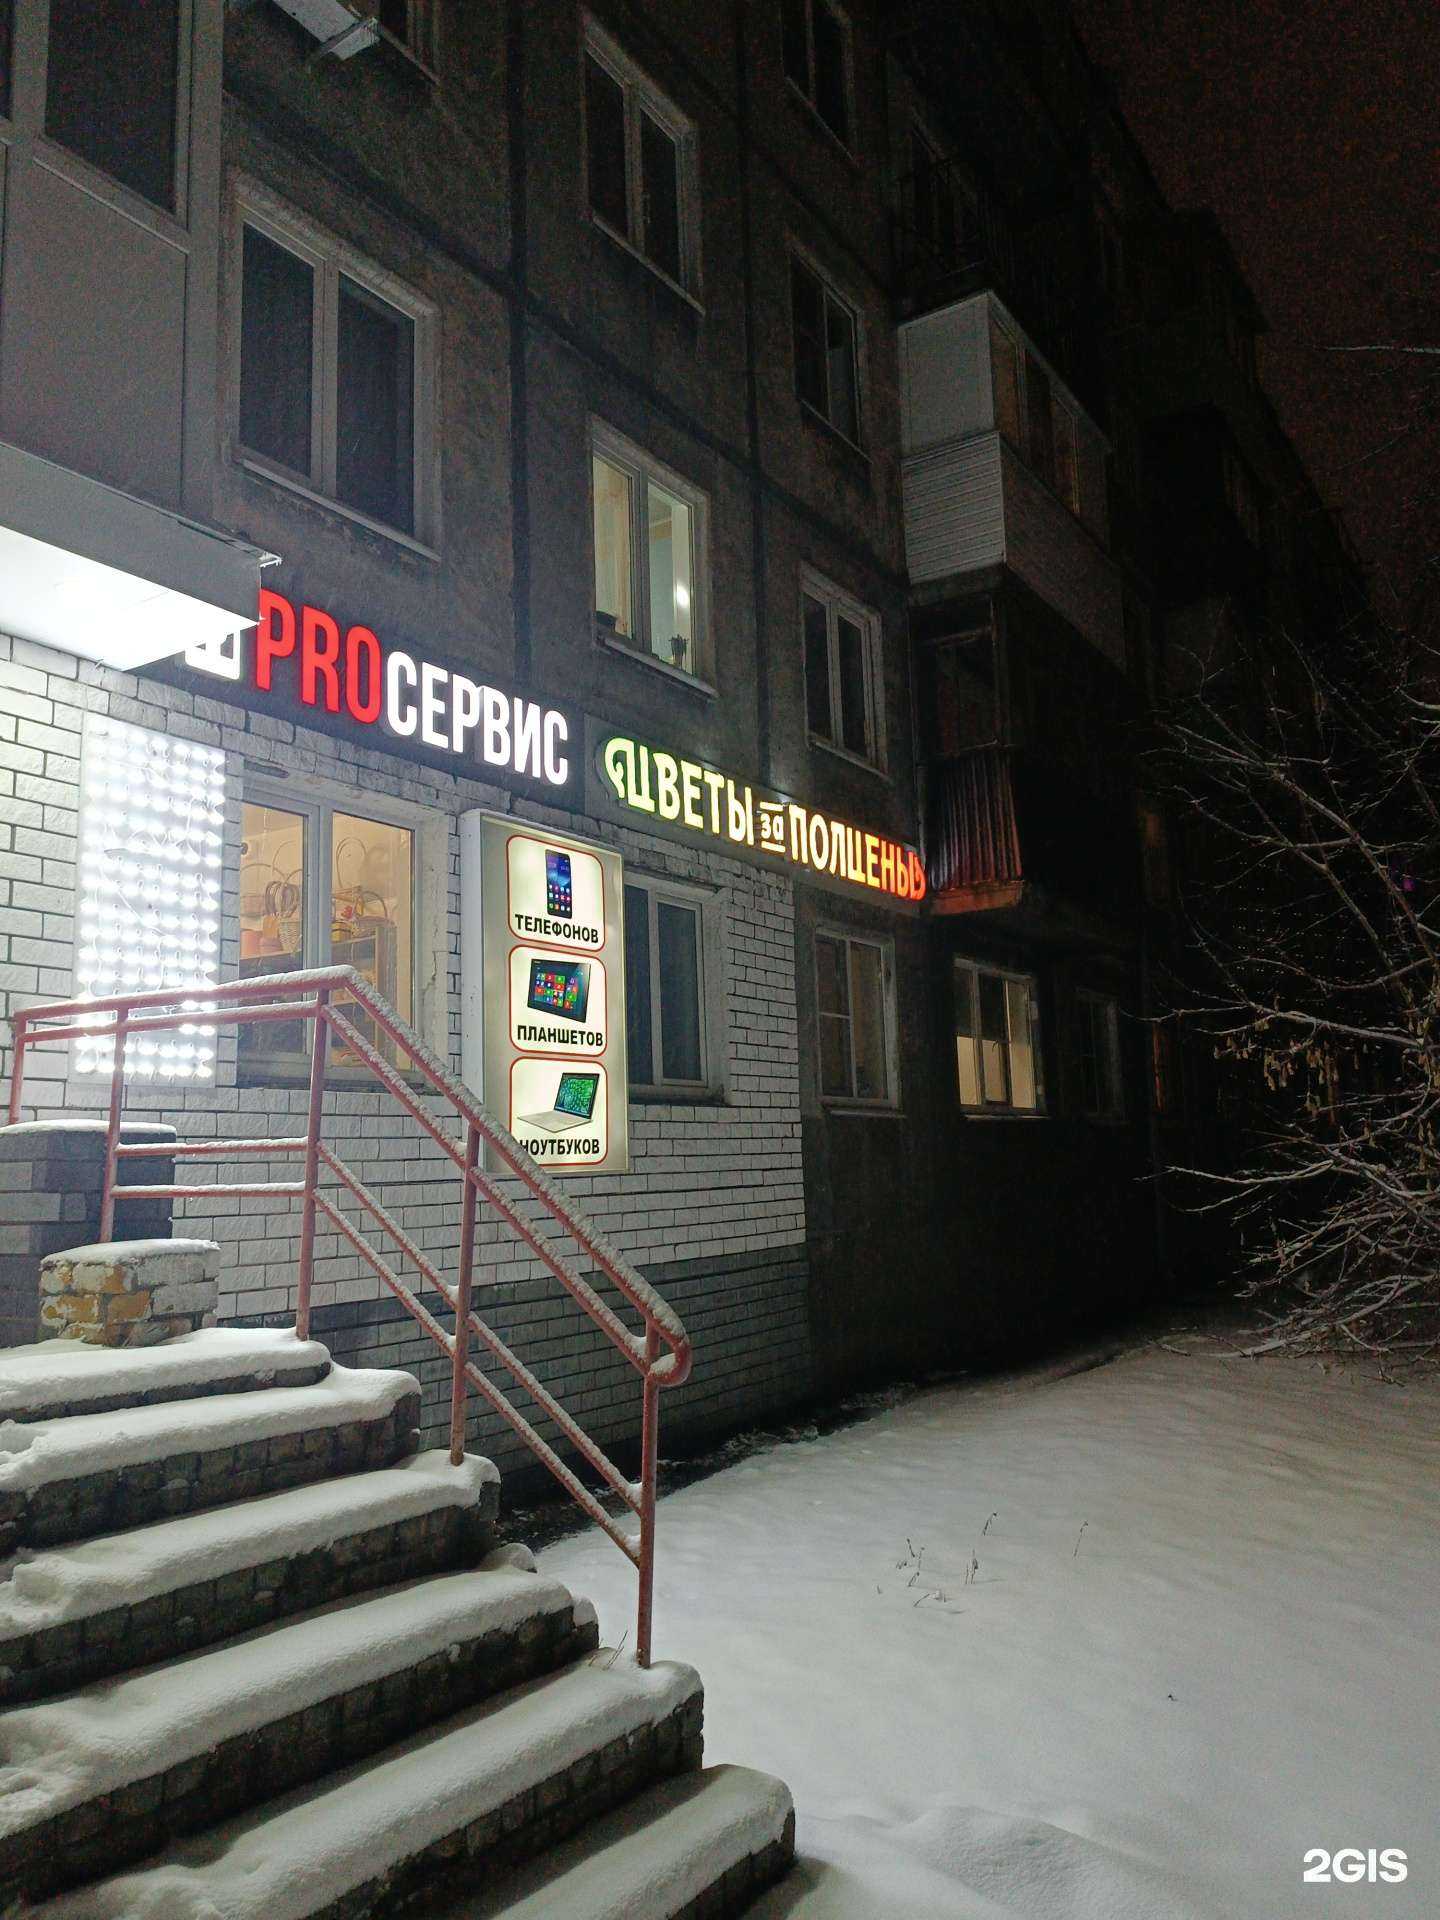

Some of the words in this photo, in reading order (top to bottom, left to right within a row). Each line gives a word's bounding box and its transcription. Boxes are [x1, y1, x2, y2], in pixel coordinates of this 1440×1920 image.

[605, 737, 755, 847] ЦВЕТЫ
[789, 804, 927, 901] ПОЛЦЕНЫ
[515, 914, 600, 944] ТЕЛЕФОНОВ
[517, 1024, 604, 1047] ПЛАНШЕТОВ
